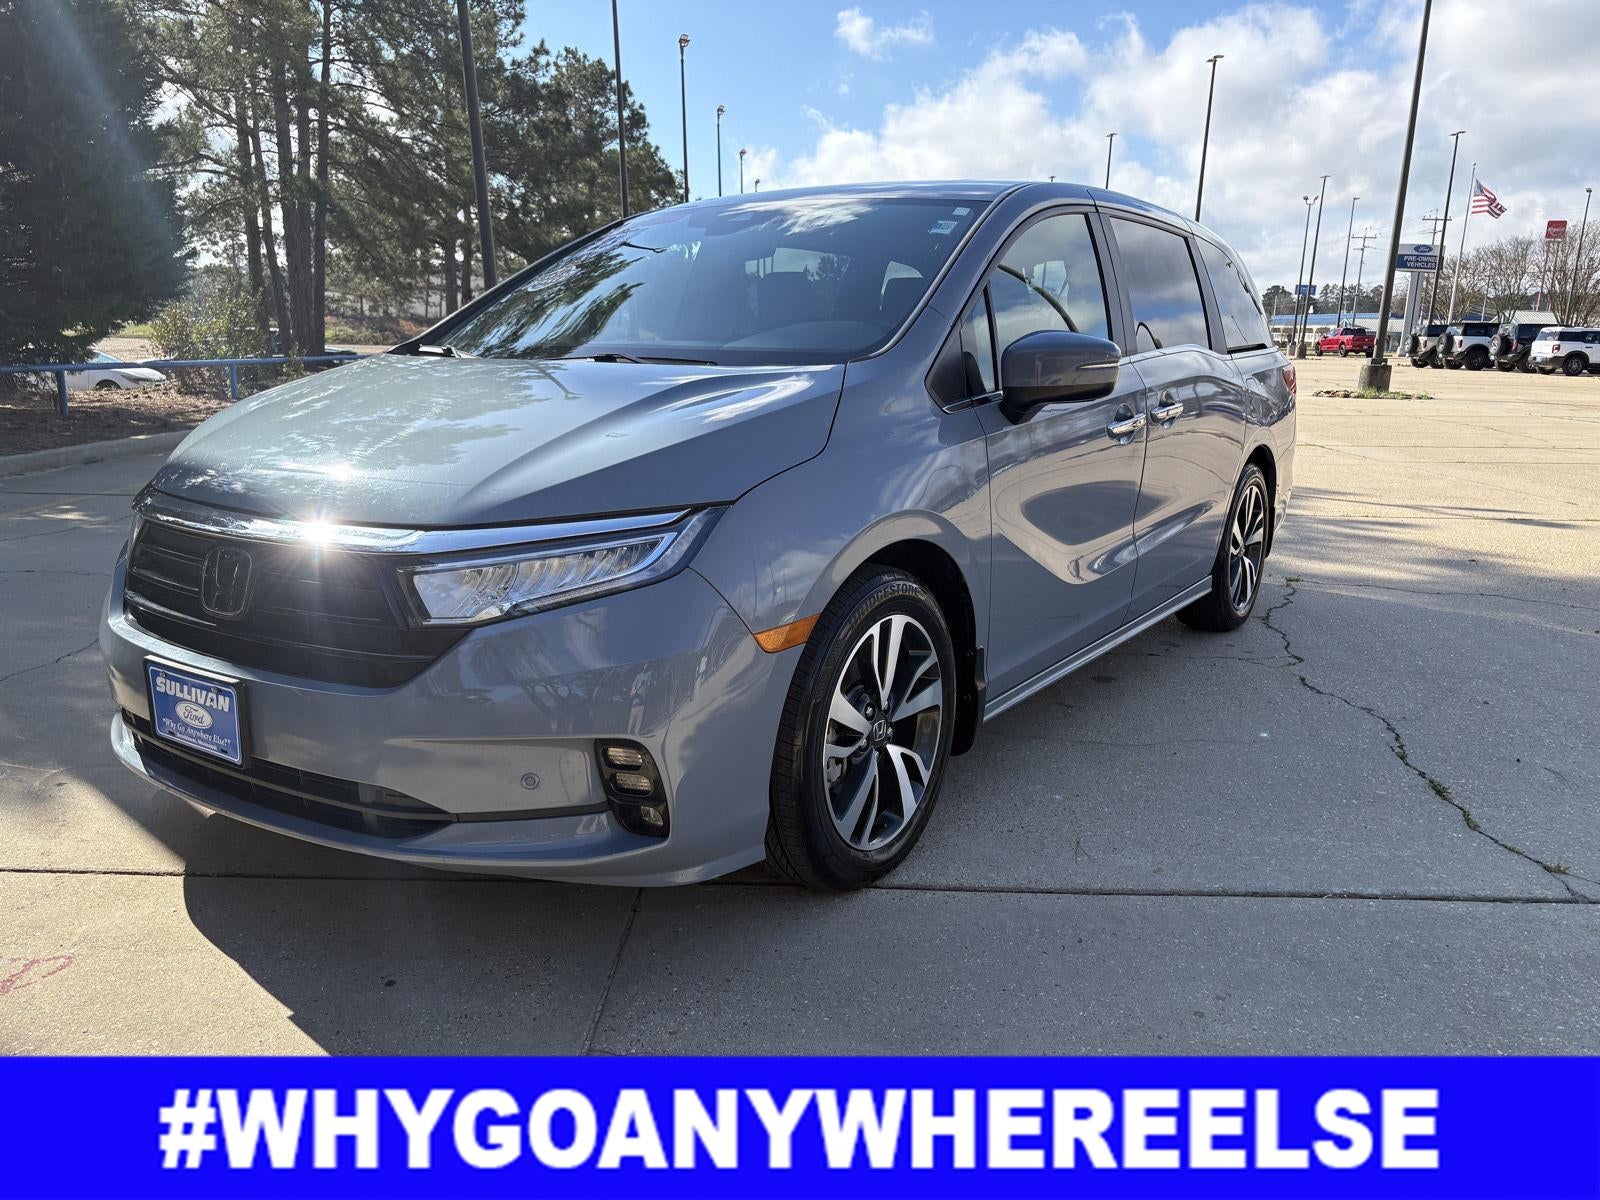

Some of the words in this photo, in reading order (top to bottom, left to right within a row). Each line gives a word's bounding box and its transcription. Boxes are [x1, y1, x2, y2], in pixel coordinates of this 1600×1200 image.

[156, 676, 230, 712] SULLIVAN
[183, 706, 205, 725] Ford
[186, 726, 212, 741] Anywhere
